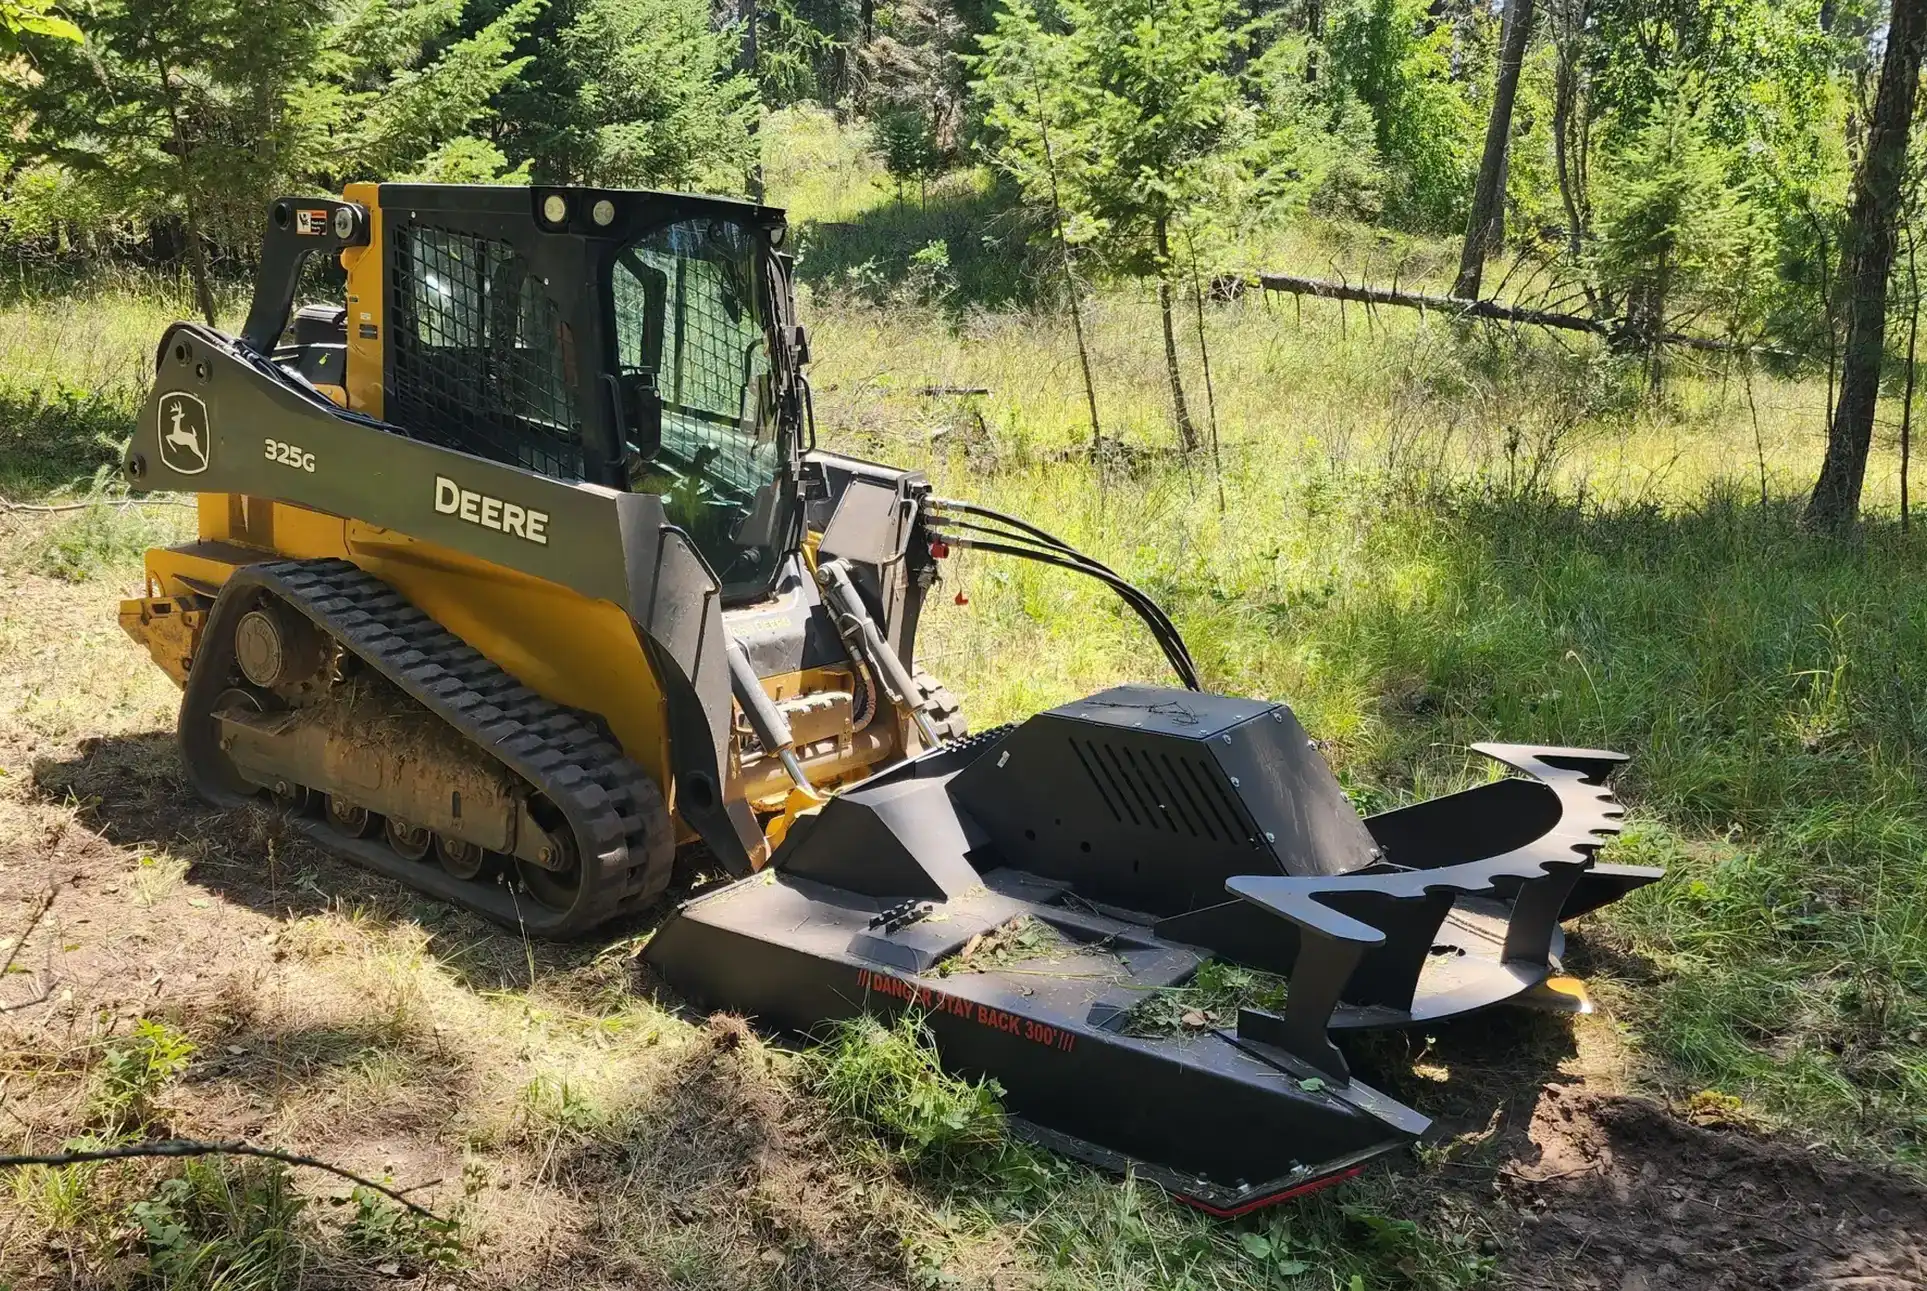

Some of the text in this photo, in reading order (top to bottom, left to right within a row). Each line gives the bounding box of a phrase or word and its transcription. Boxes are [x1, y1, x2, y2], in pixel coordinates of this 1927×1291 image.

[264, 438, 315, 473] 325G
[435, 476, 549, 544] DEERE
[936, 991, 974, 1019] STAY
[977, 1005, 1021, 1036] BACK
